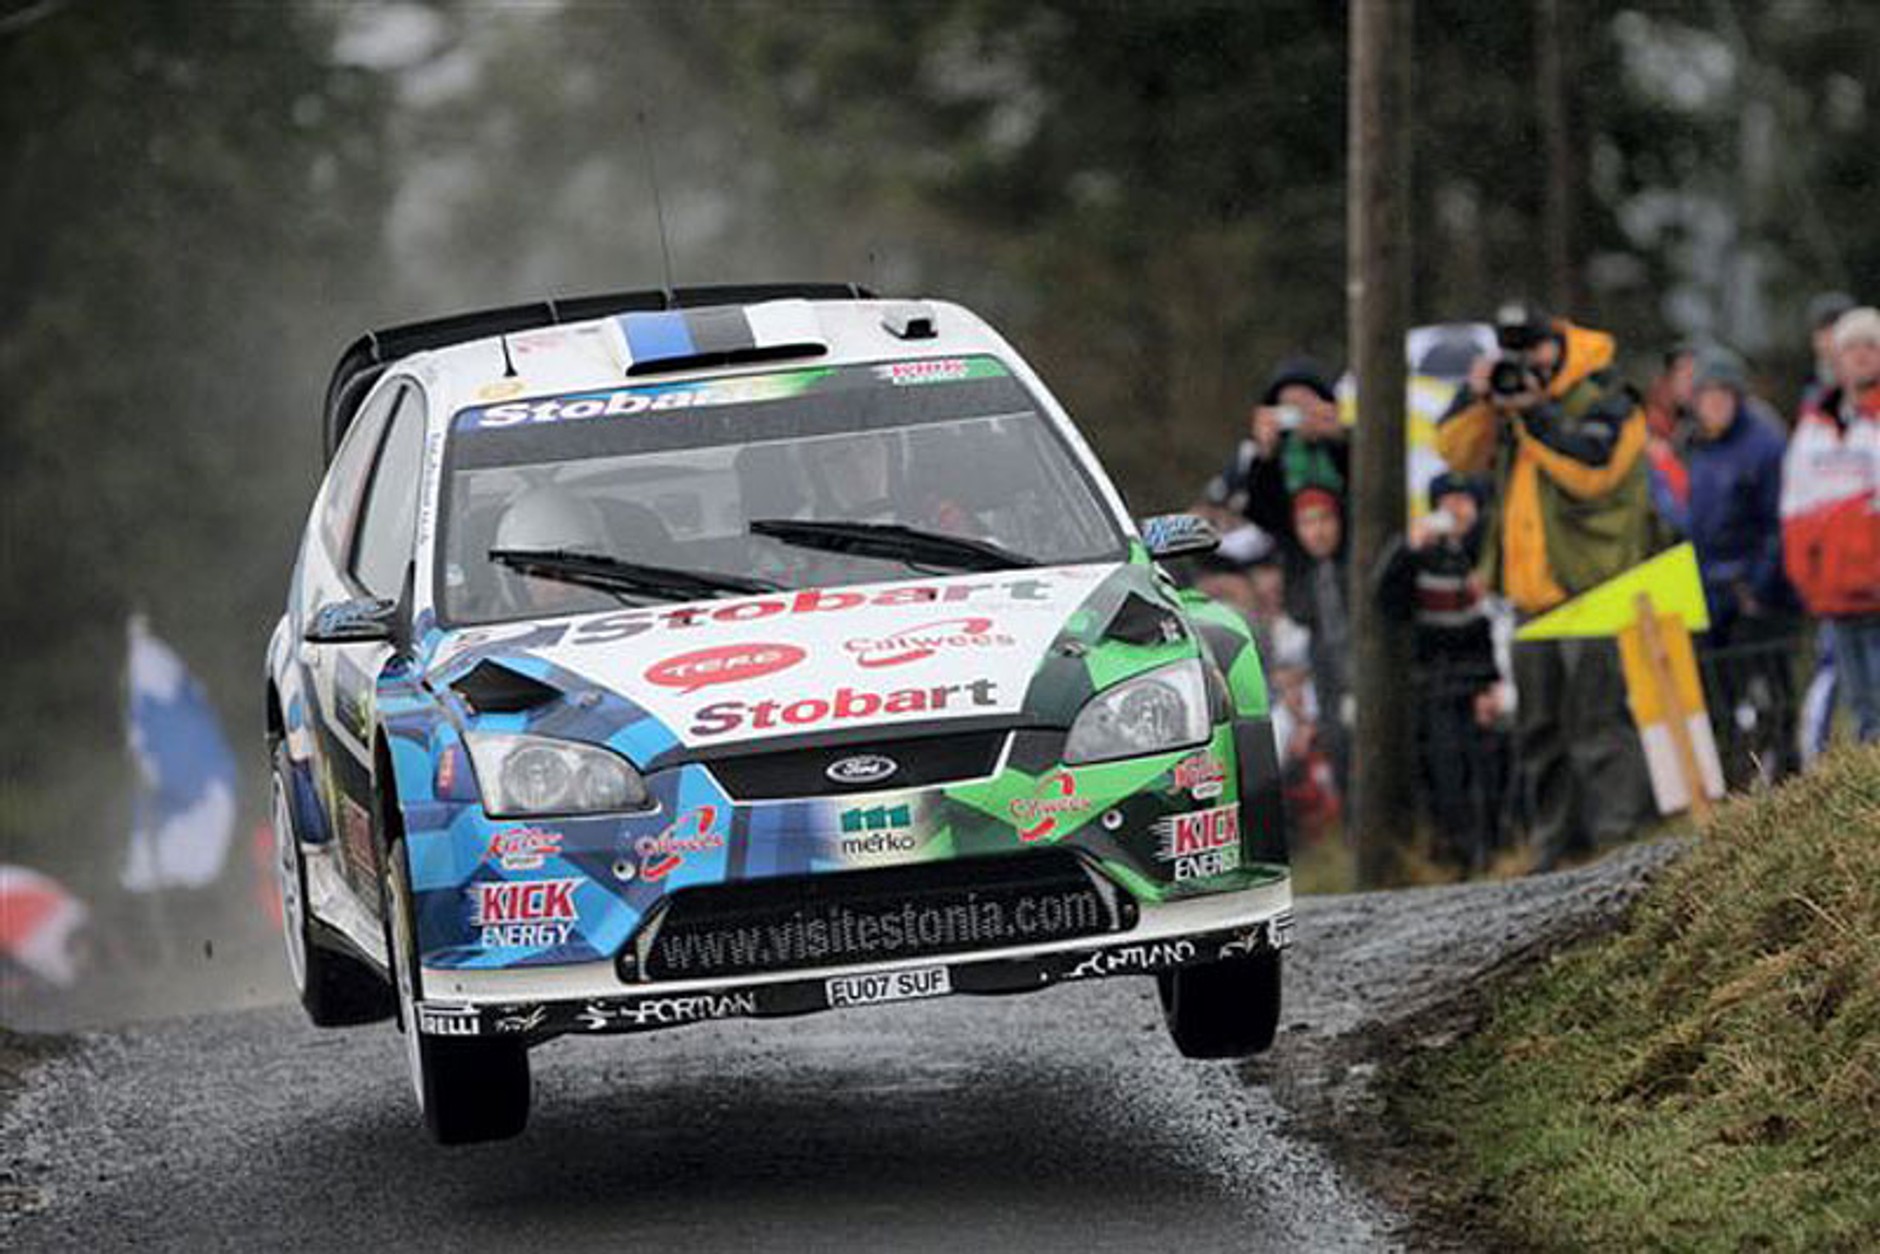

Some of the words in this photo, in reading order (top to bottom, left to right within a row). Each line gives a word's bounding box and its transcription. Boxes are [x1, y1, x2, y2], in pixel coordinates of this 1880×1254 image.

[572, 580, 1053, 645] Stobart
[689, 678, 998, 736] Stobart
[483, 880, 575, 921] KICK
[481, 920, 575, 948] ENERGY
[660, 889, 1099, 969] www.visitestonia.com
[831, 976, 890, 1001] EU07
[897, 969, 944, 995] SUF
[420, 1015, 480, 1035] RELLI
